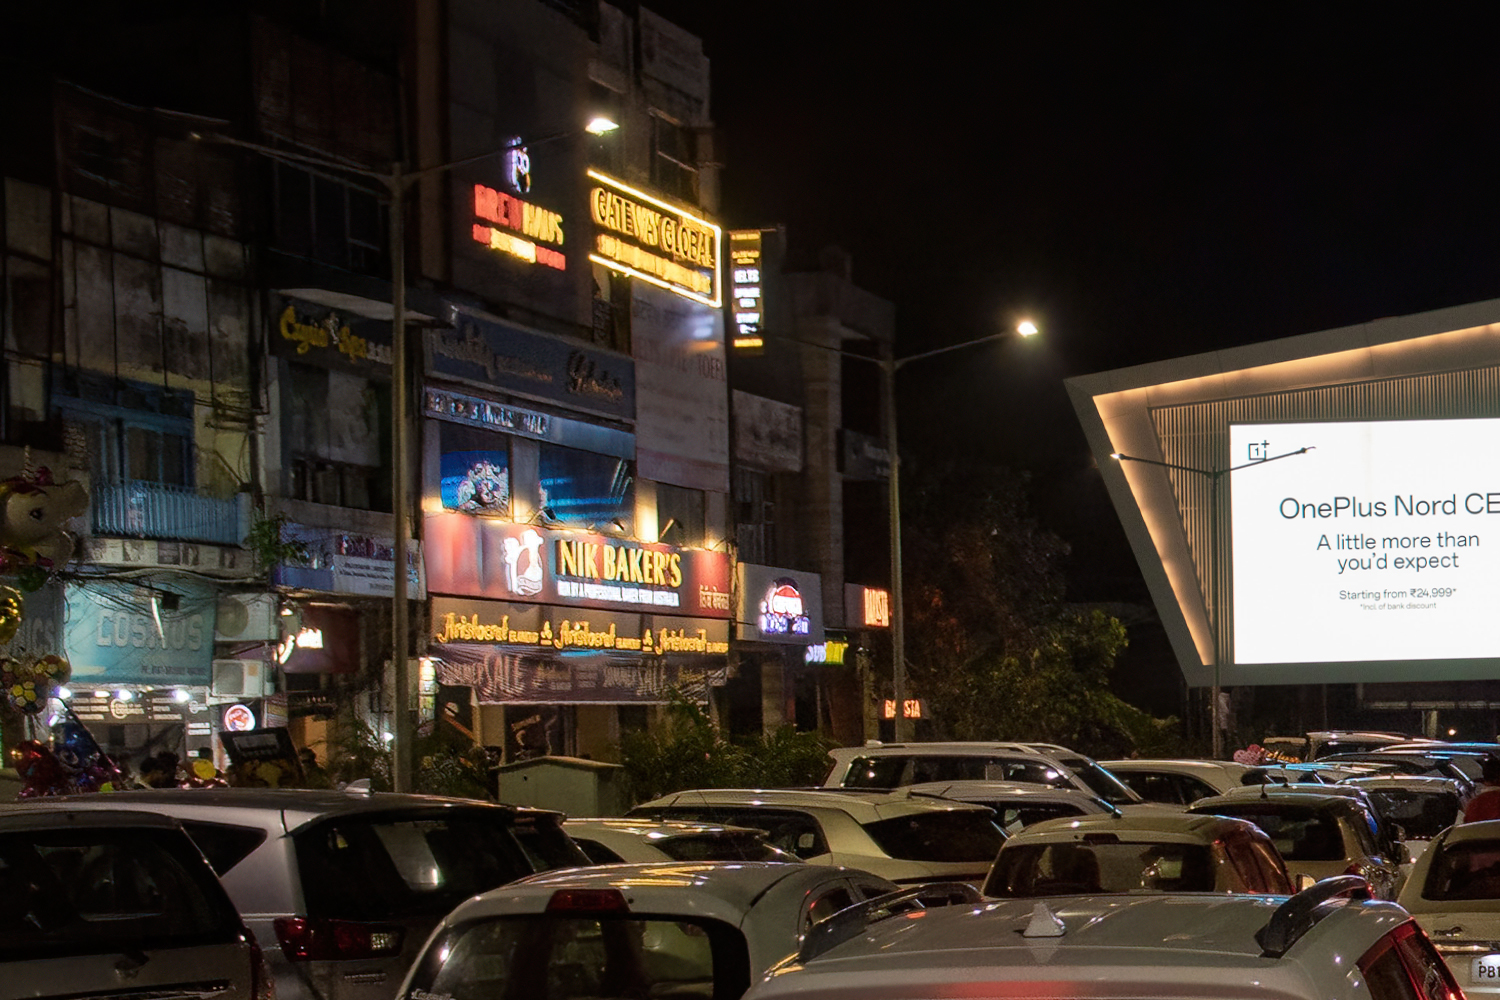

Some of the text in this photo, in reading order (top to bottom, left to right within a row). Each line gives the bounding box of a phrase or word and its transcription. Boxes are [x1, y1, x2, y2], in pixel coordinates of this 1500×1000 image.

[591, 188, 660, 246] GATEWAY
[659, 216, 715, 268] GLOBAL
[1280, 496, 1386, 519] OnePlus
[1395, 494, 1456, 516] Nord
[1316, 531, 1479, 550] A little more than
[558, 540, 682, 588] NIK BAKER'S
[1393, 552, 1460, 573] expect
[1339, 589, 1381, 601] Starting
[1383, 588, 1407, 599] from
[1379, 602, 1386, 611] of
[1387, 602, 1404, 611] bank
[1406, 602, 1437, 610] discount
